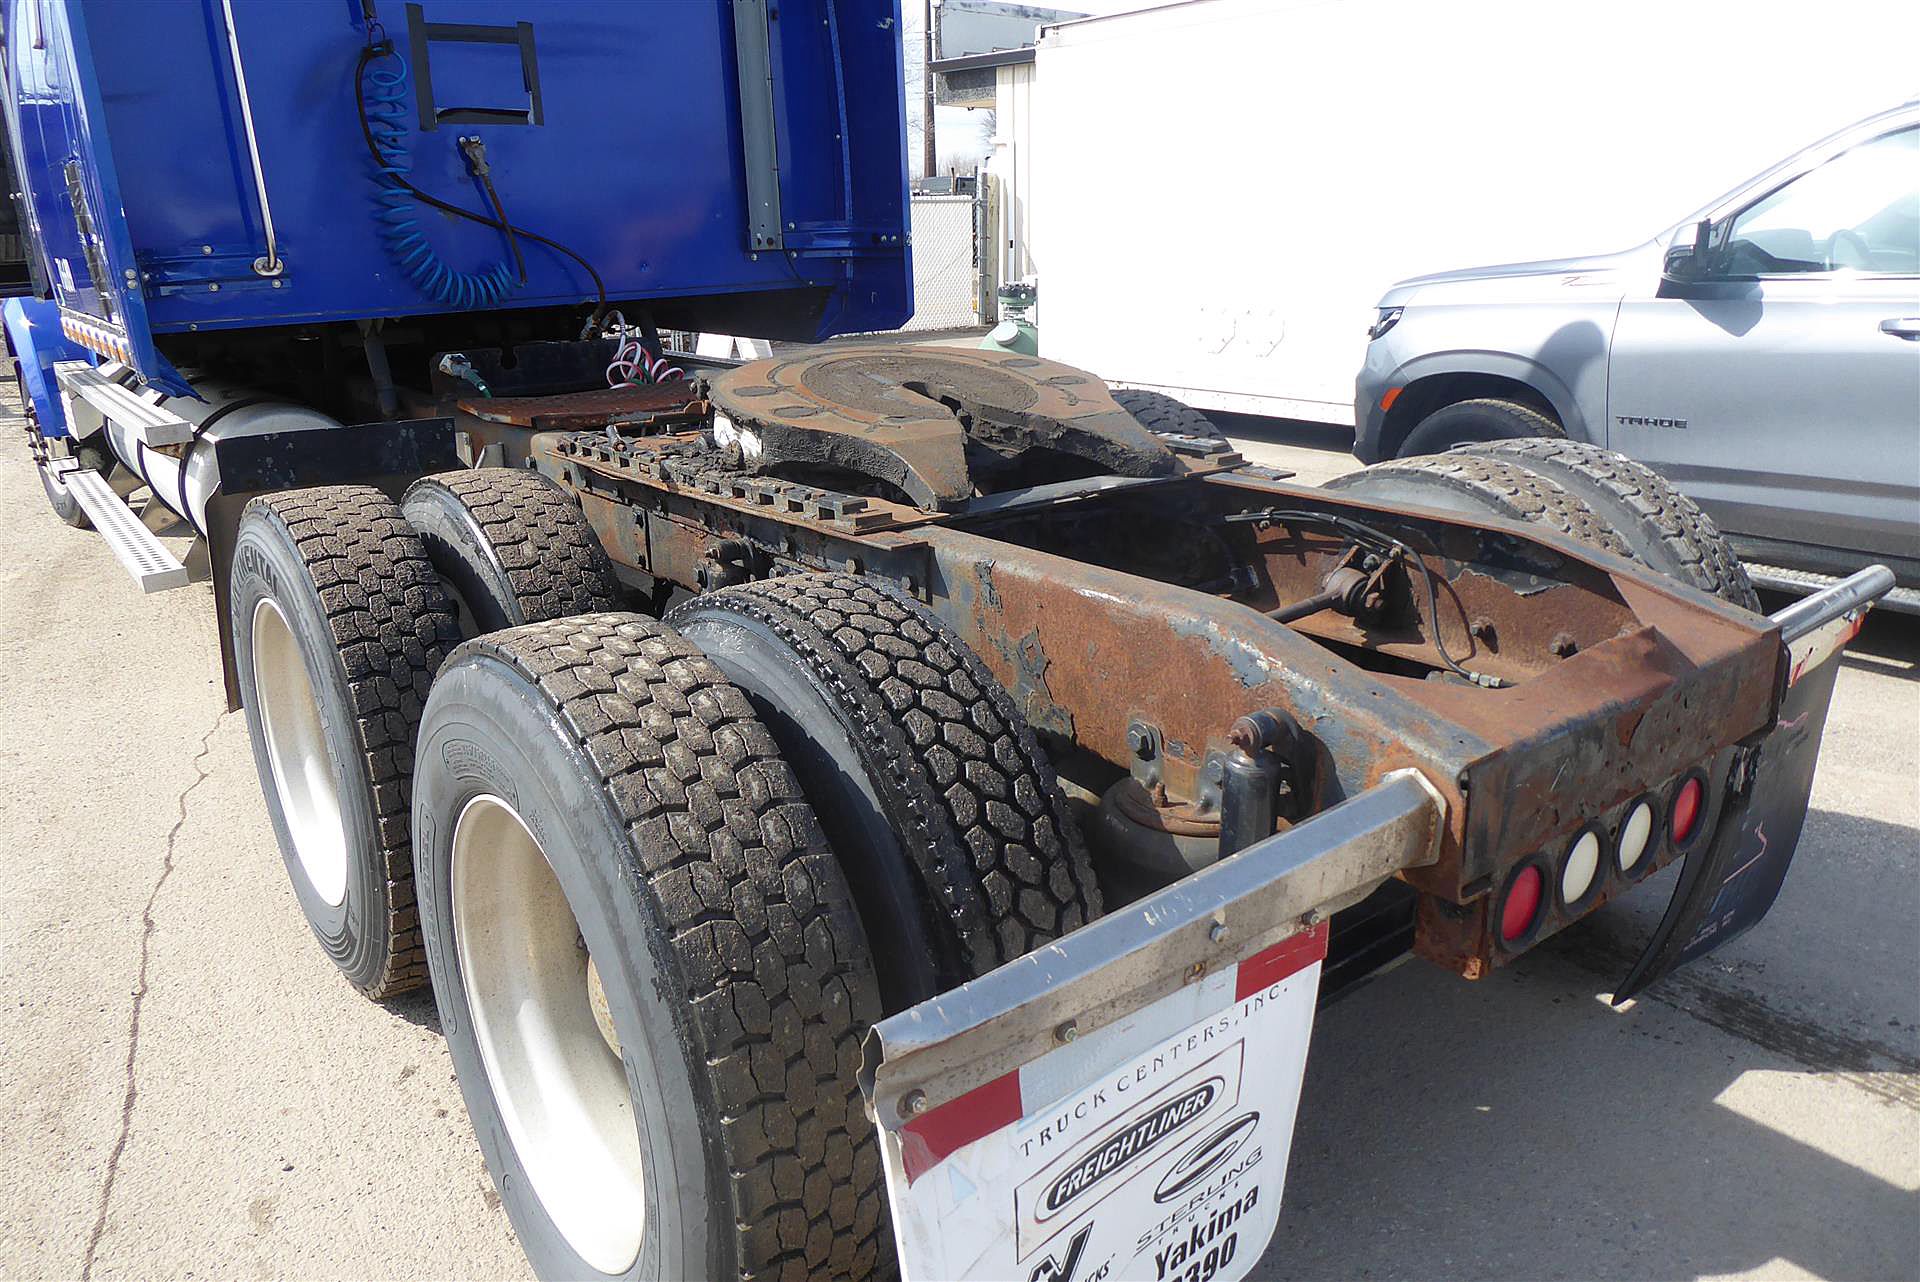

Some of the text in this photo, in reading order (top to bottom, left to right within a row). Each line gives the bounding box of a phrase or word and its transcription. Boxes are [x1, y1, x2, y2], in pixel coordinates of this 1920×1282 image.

[1616, 415, 1688, 429] TAHOE
[1020, 985, 1288, 1157] TRUCK CENTERS, INC.
[1054, 1091, 1208, 1205] FREIGHTLINER
[1137, 1145, 1262, 1245] STERLING
[1155, 1185, 1259, 1281] Yakima
[1170, 1232, 1238, 1282] 390
